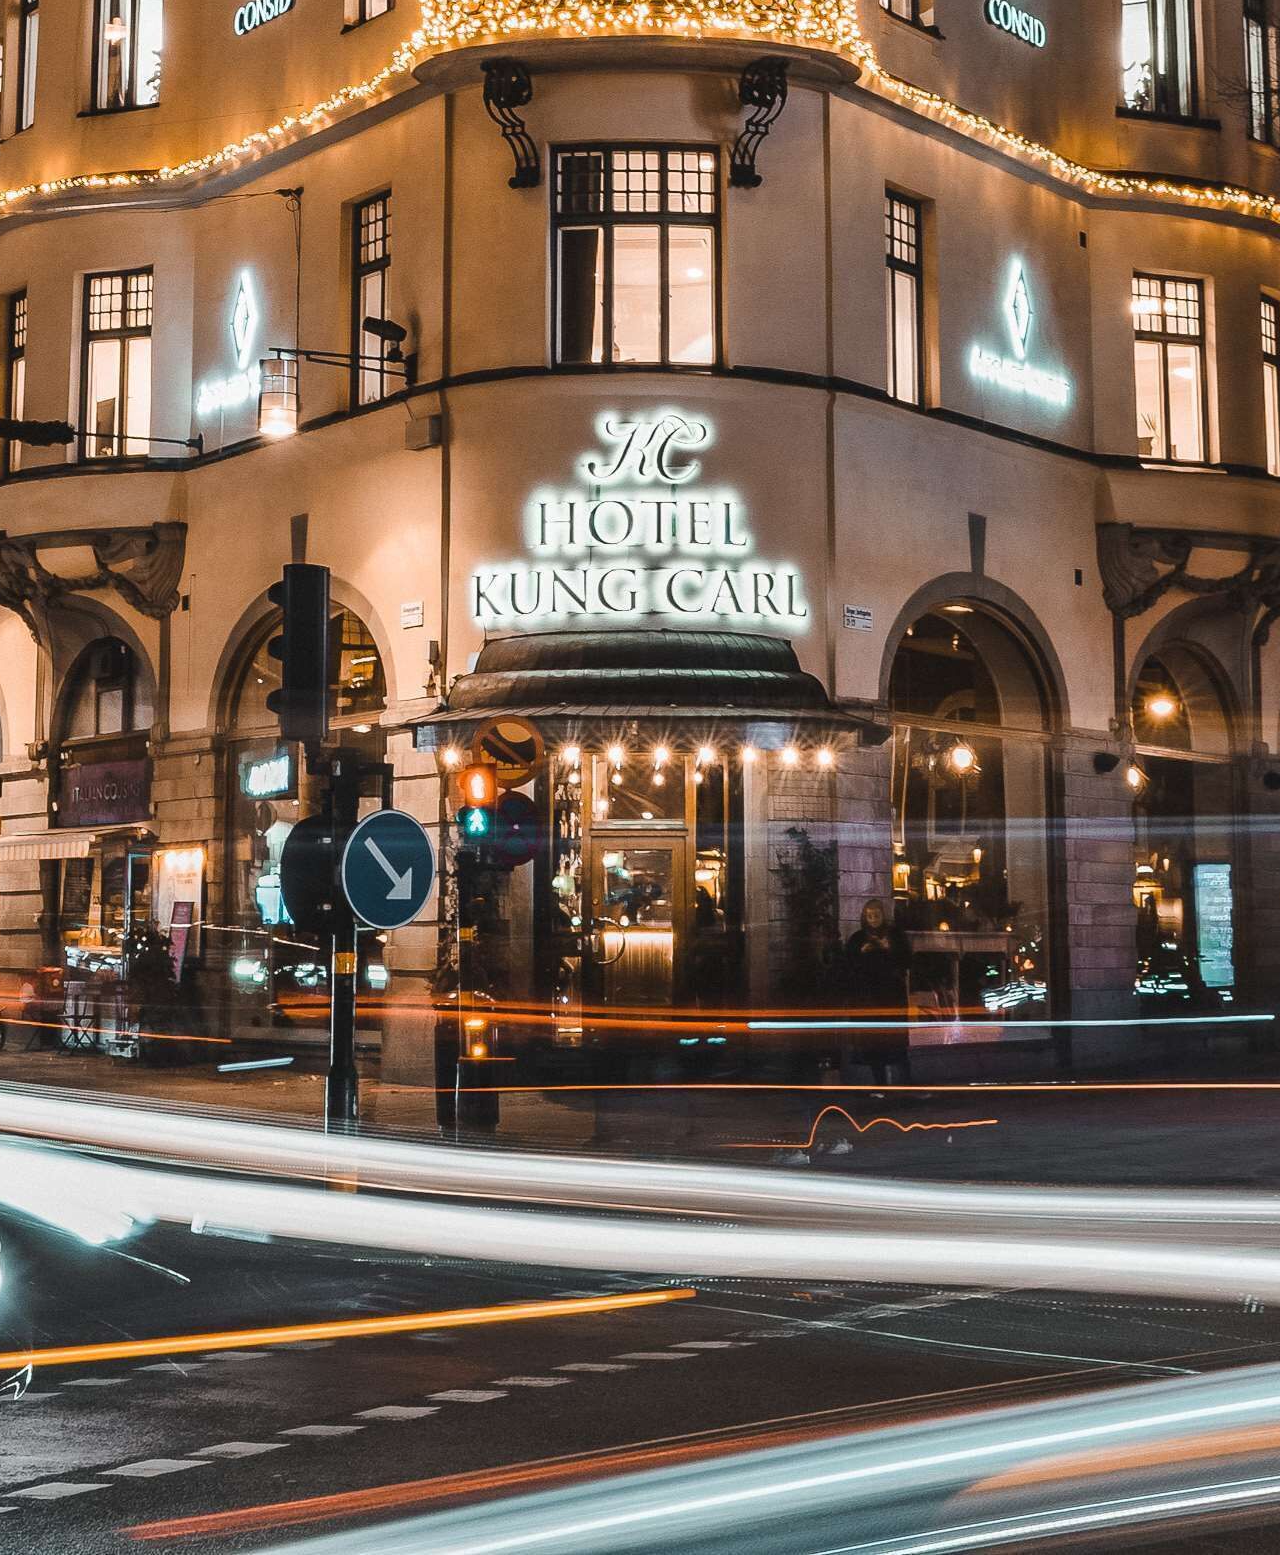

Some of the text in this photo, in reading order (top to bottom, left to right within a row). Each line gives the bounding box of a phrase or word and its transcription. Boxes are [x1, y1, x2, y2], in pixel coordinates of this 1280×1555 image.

[538, 500, 747, 546] HOTEL
[472, 569, 638, 618] KUNG
[665, 568, 808, 617] CARL
